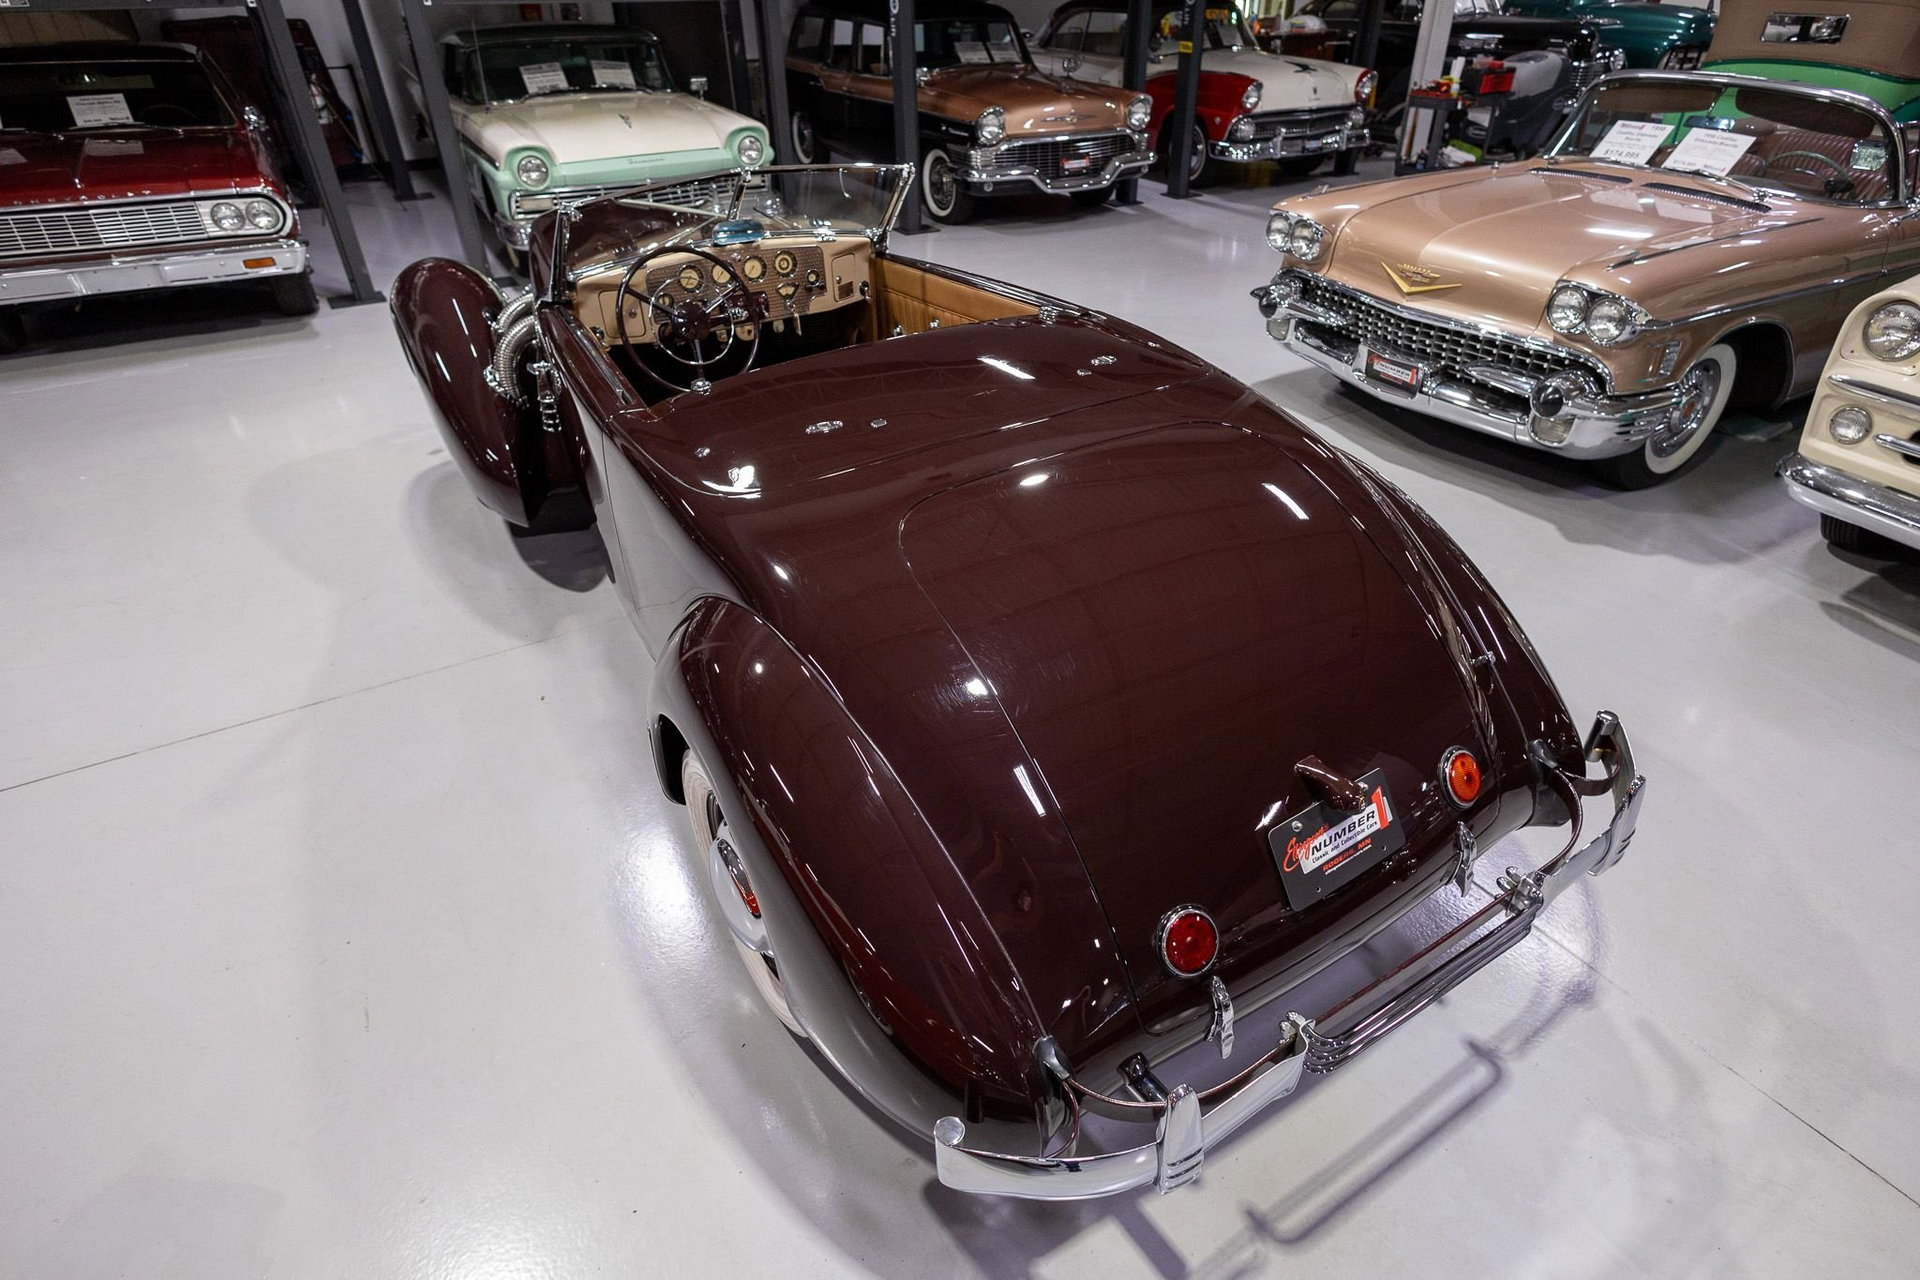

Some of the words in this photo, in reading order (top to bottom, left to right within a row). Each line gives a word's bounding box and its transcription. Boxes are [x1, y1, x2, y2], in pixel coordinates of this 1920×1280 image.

[1311, 809, 1375, 857] NUMBER
[1371, 784, 1392, 831] 1
[1311, 849, 1329, 864] Classic
[1330, 842, 1341, 853] and
[1341, 827, 1366, 847] Collectible
[1366, 821, 1378, 832] Cars
